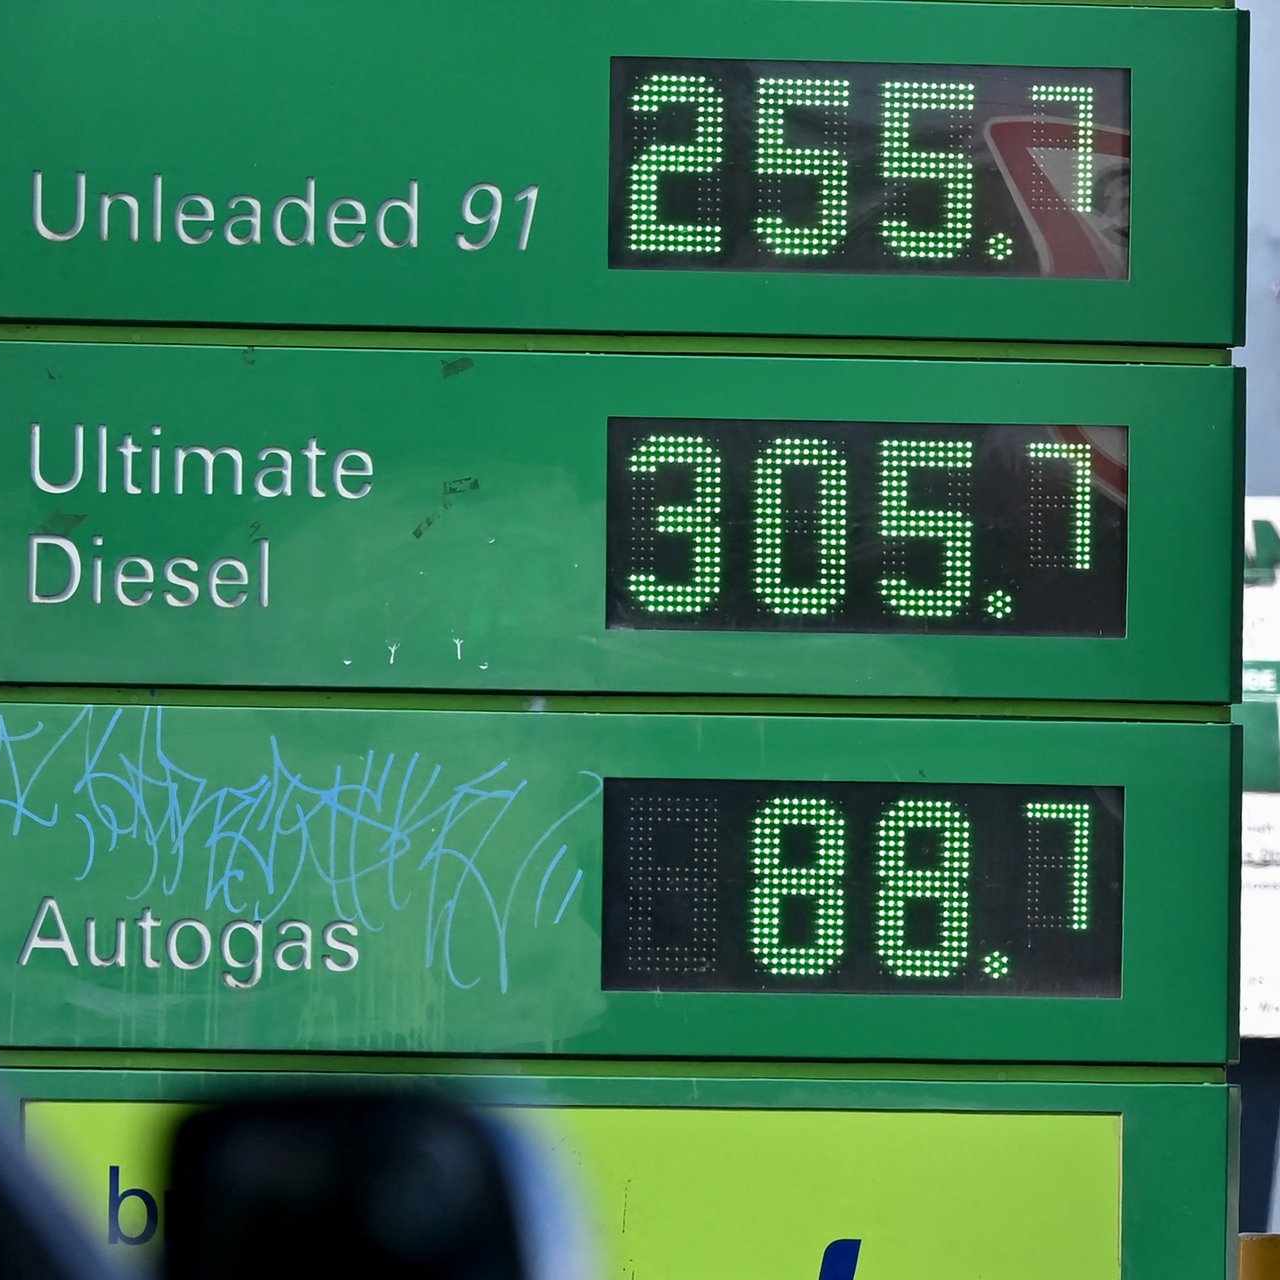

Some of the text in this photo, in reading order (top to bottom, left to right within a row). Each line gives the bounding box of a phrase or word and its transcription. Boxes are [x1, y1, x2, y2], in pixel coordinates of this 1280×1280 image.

[32, 171, 541, 252] Unleaded 91
[29, 423, 376, 501] Ultimate
[28, 534, 271, 610] Diesel
[19, 897, 361, 990] Autogas
